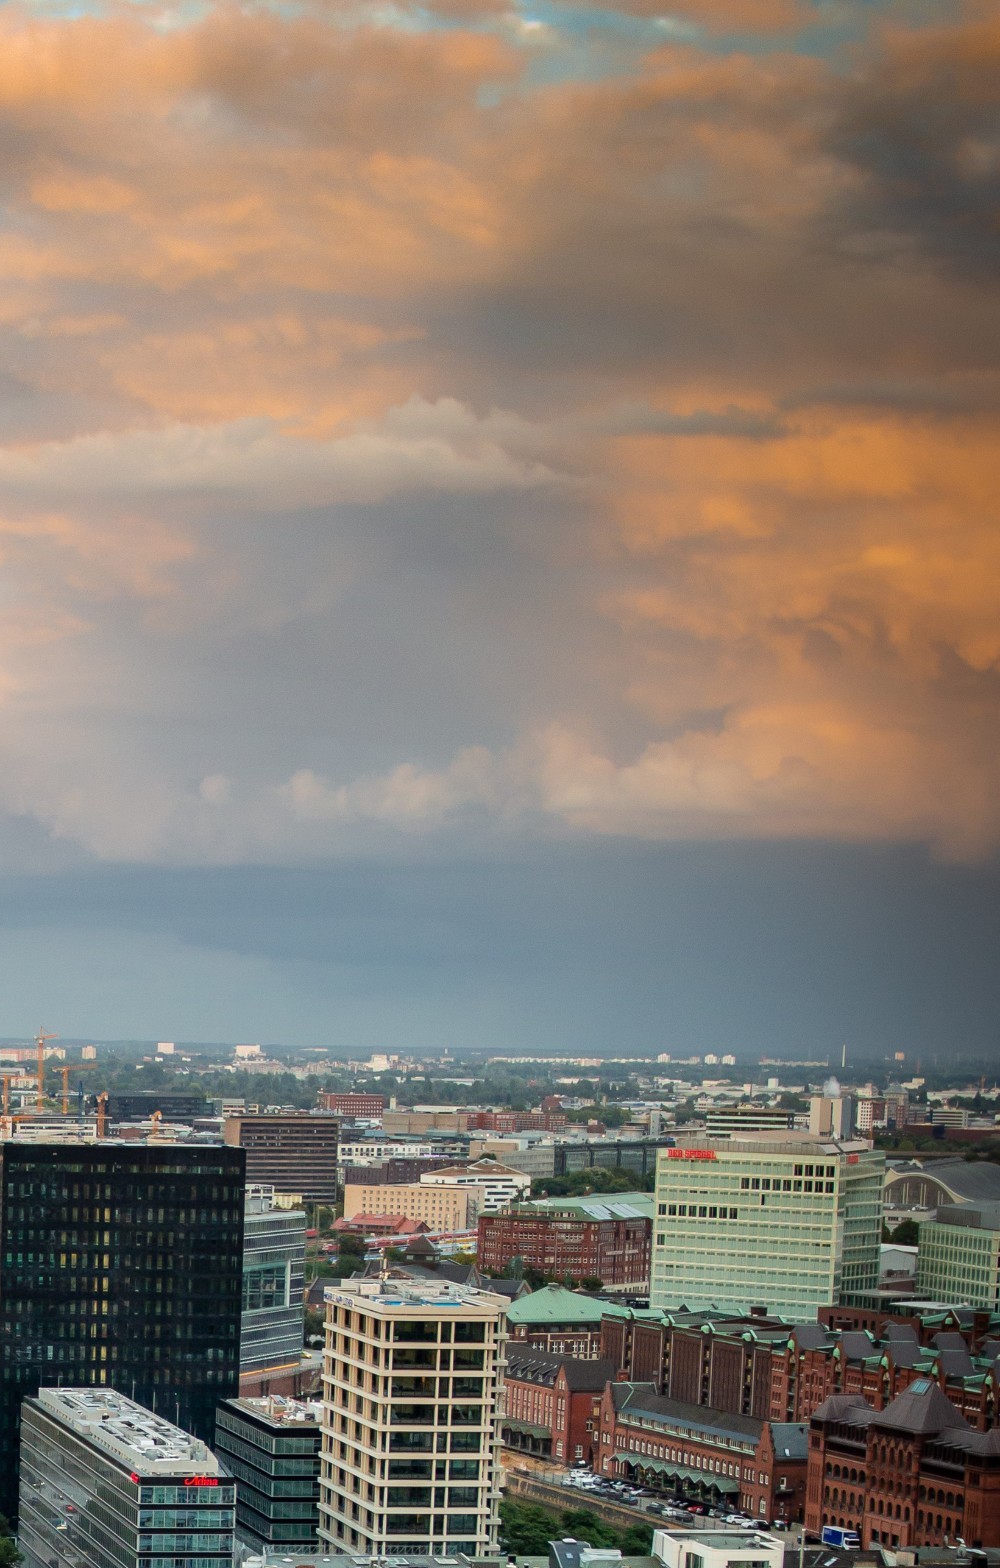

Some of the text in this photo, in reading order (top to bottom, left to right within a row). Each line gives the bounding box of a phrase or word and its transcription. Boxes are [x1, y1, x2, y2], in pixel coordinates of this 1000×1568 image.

[668, 1149, 717, 1160] DER SPIEGEL
[184, 1475, 218, 1486] Adina
